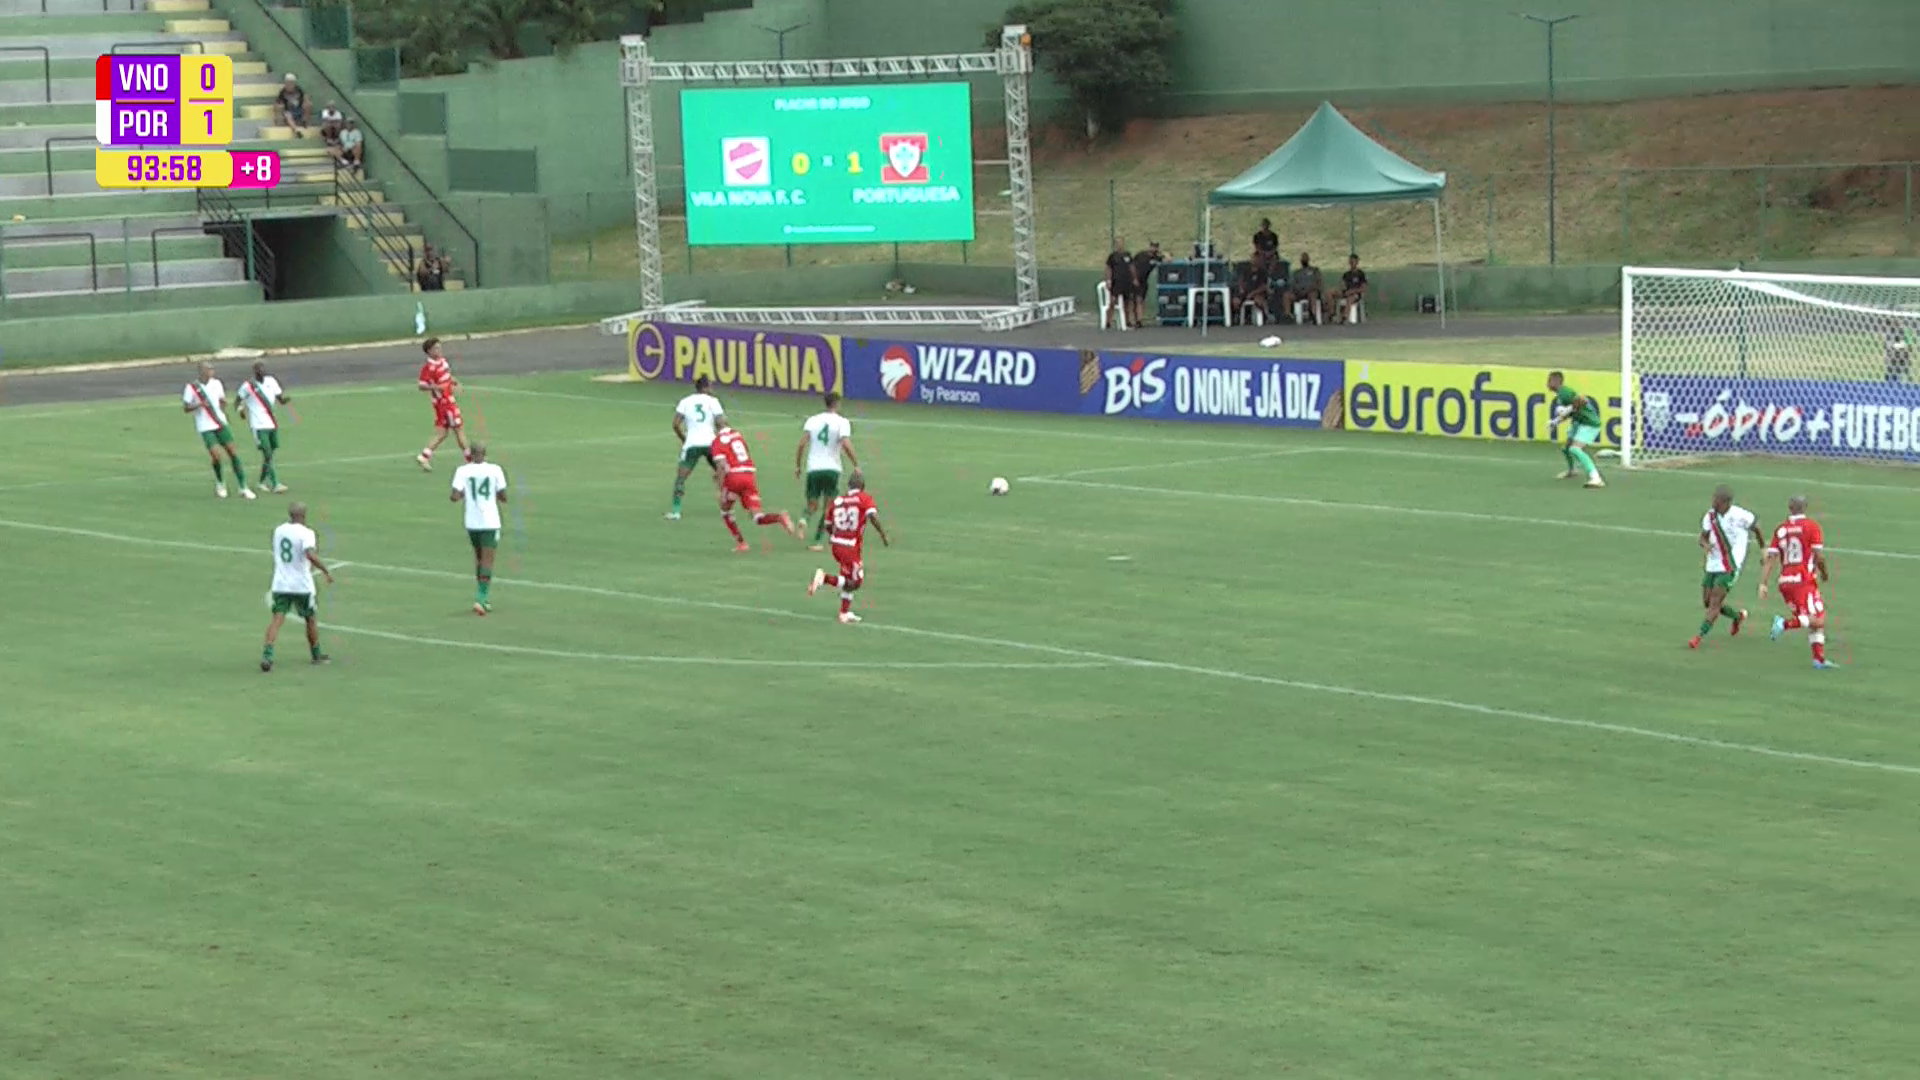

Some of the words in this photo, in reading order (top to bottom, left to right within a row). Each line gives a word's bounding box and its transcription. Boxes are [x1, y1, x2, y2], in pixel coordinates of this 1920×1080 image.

[792, 152, 811, 176] 0
[847, 151, 864, 174] 1
[690, 190, 728, 207] VILA
[728, 189, 775, 206] NOVA
[852, 186, 961, 204] PORTUGUESA
[673, 332, 826, 394] PAULÍNIA
[916, 345, 1037, 387] WIZARD
[920, 383, 934, 404] by
[936, 386, 981, 404] Pearson
[1174, 366, 1191, 414] O
[1193, 367, 1252, 417] NOME
[1255, 363, 1284, 419] JÁ
[1285, 372, 1322, 421] DIZ
[694, 403, 706, 423] 3
[817, 422, 830, 447] 4
[468, 475, 491, 501] 14
[280, 537, 293, 563] 8
[1778, 536, 1804, 565] 18
